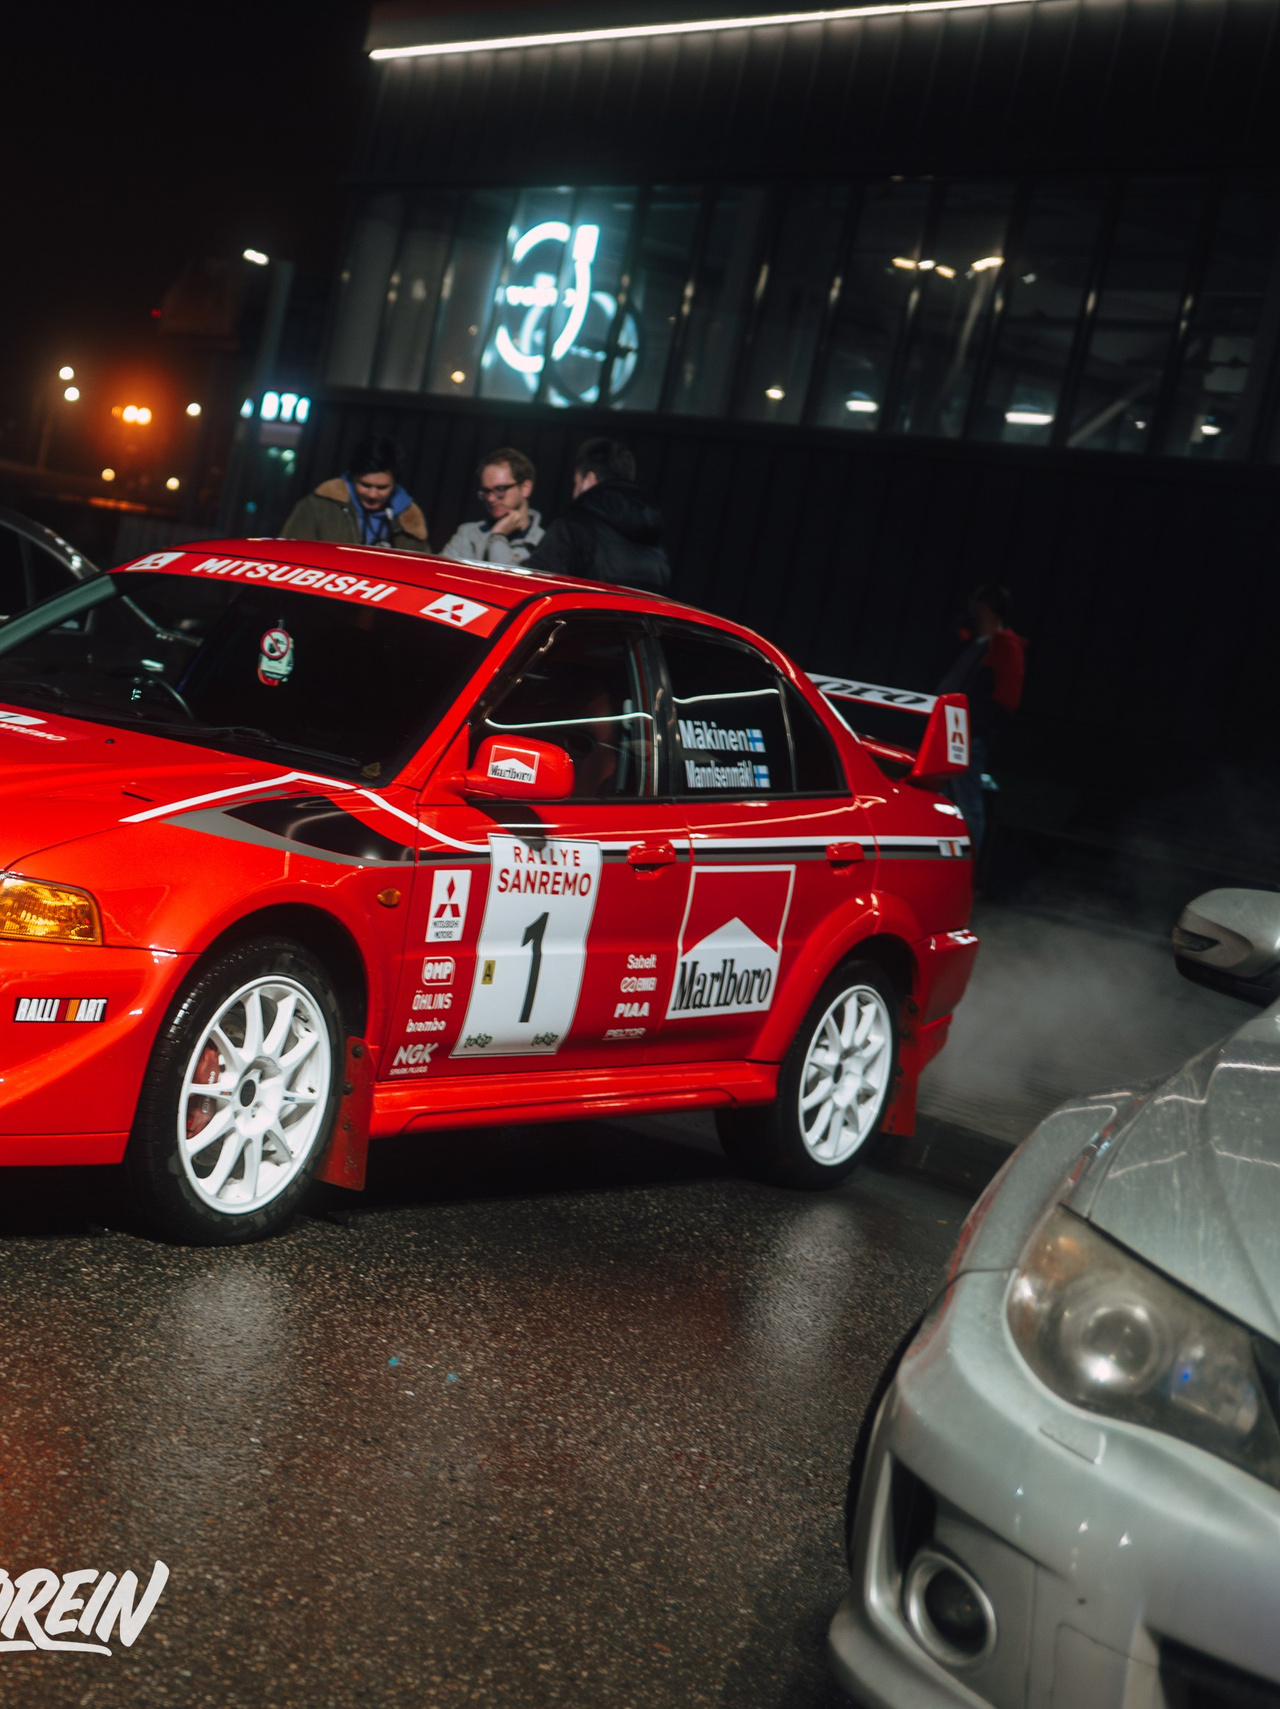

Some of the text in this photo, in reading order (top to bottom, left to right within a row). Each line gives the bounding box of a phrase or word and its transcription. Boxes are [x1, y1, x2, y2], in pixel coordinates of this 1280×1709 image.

[191, 557, 398, 602] MITSUBISHI
[678, 719, 751, 752] Mäkinen
[490, 764, 533, 782] Marlboro
[513, 846, 581, 867] RALLYE
[497, 868, 592, 897] SANREMO
[423, 961, 453, 980] OMP
[482, 963, 492, 981] A
[520, 912, 550, 1023] 1
[626, 953, 658, 970] Sabelt
[671, 958, 772, 1011] Marlboro
[613, 1002, 650, 1018] PIAA
[405, 1018, 447, 1033] brembo
[392, 1042, 439, 1066] NGK
